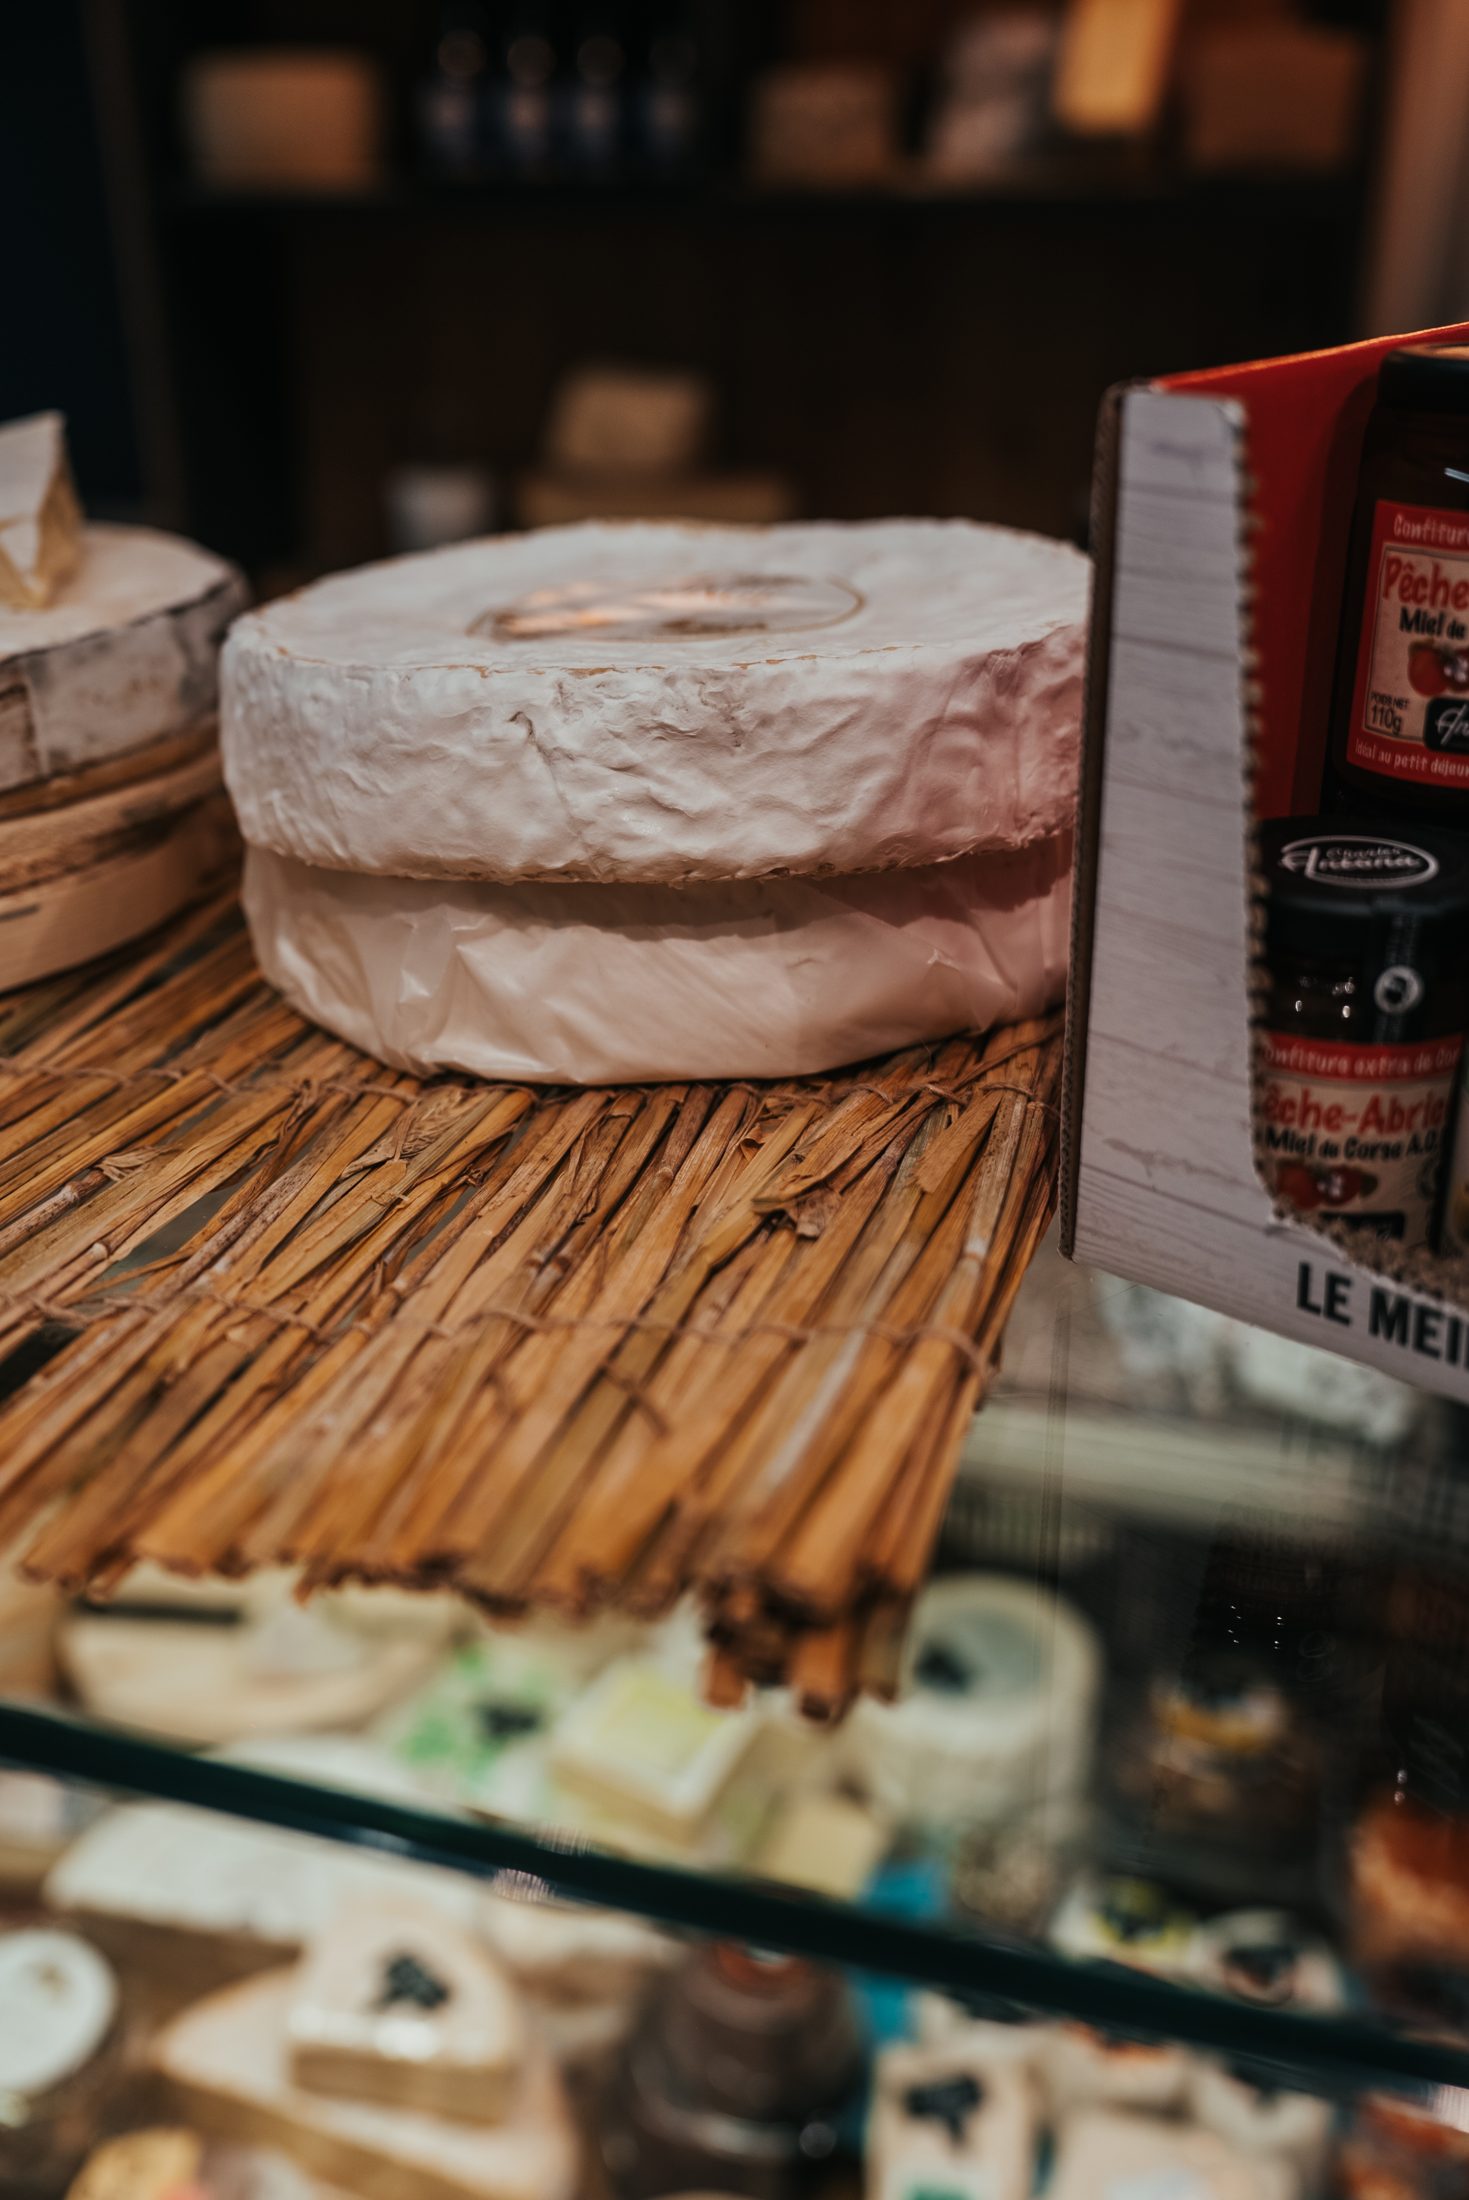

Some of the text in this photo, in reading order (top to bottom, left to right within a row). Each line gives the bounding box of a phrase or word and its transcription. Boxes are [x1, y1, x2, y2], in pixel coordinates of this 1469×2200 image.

[1383, 555, 1469, 611] Pêche
[1399, 607, 1466, 639] Miel de
[1371, 703, 1402, 736] 110g
[1378, 749, 1392, 763] au
[1394, 753, 1428, 771] petit
[1264, 1043, 1349, 1074] onfiture
[1354, 1053, 1410, 1077] extra
[1414, 1051, 1431, 1072] de
[1263, 1082, 1446, 1135] êche-Abric
[1265, 1126, 1317, 1157] Miel
[1296, 1260, 1352, 1326] LE
